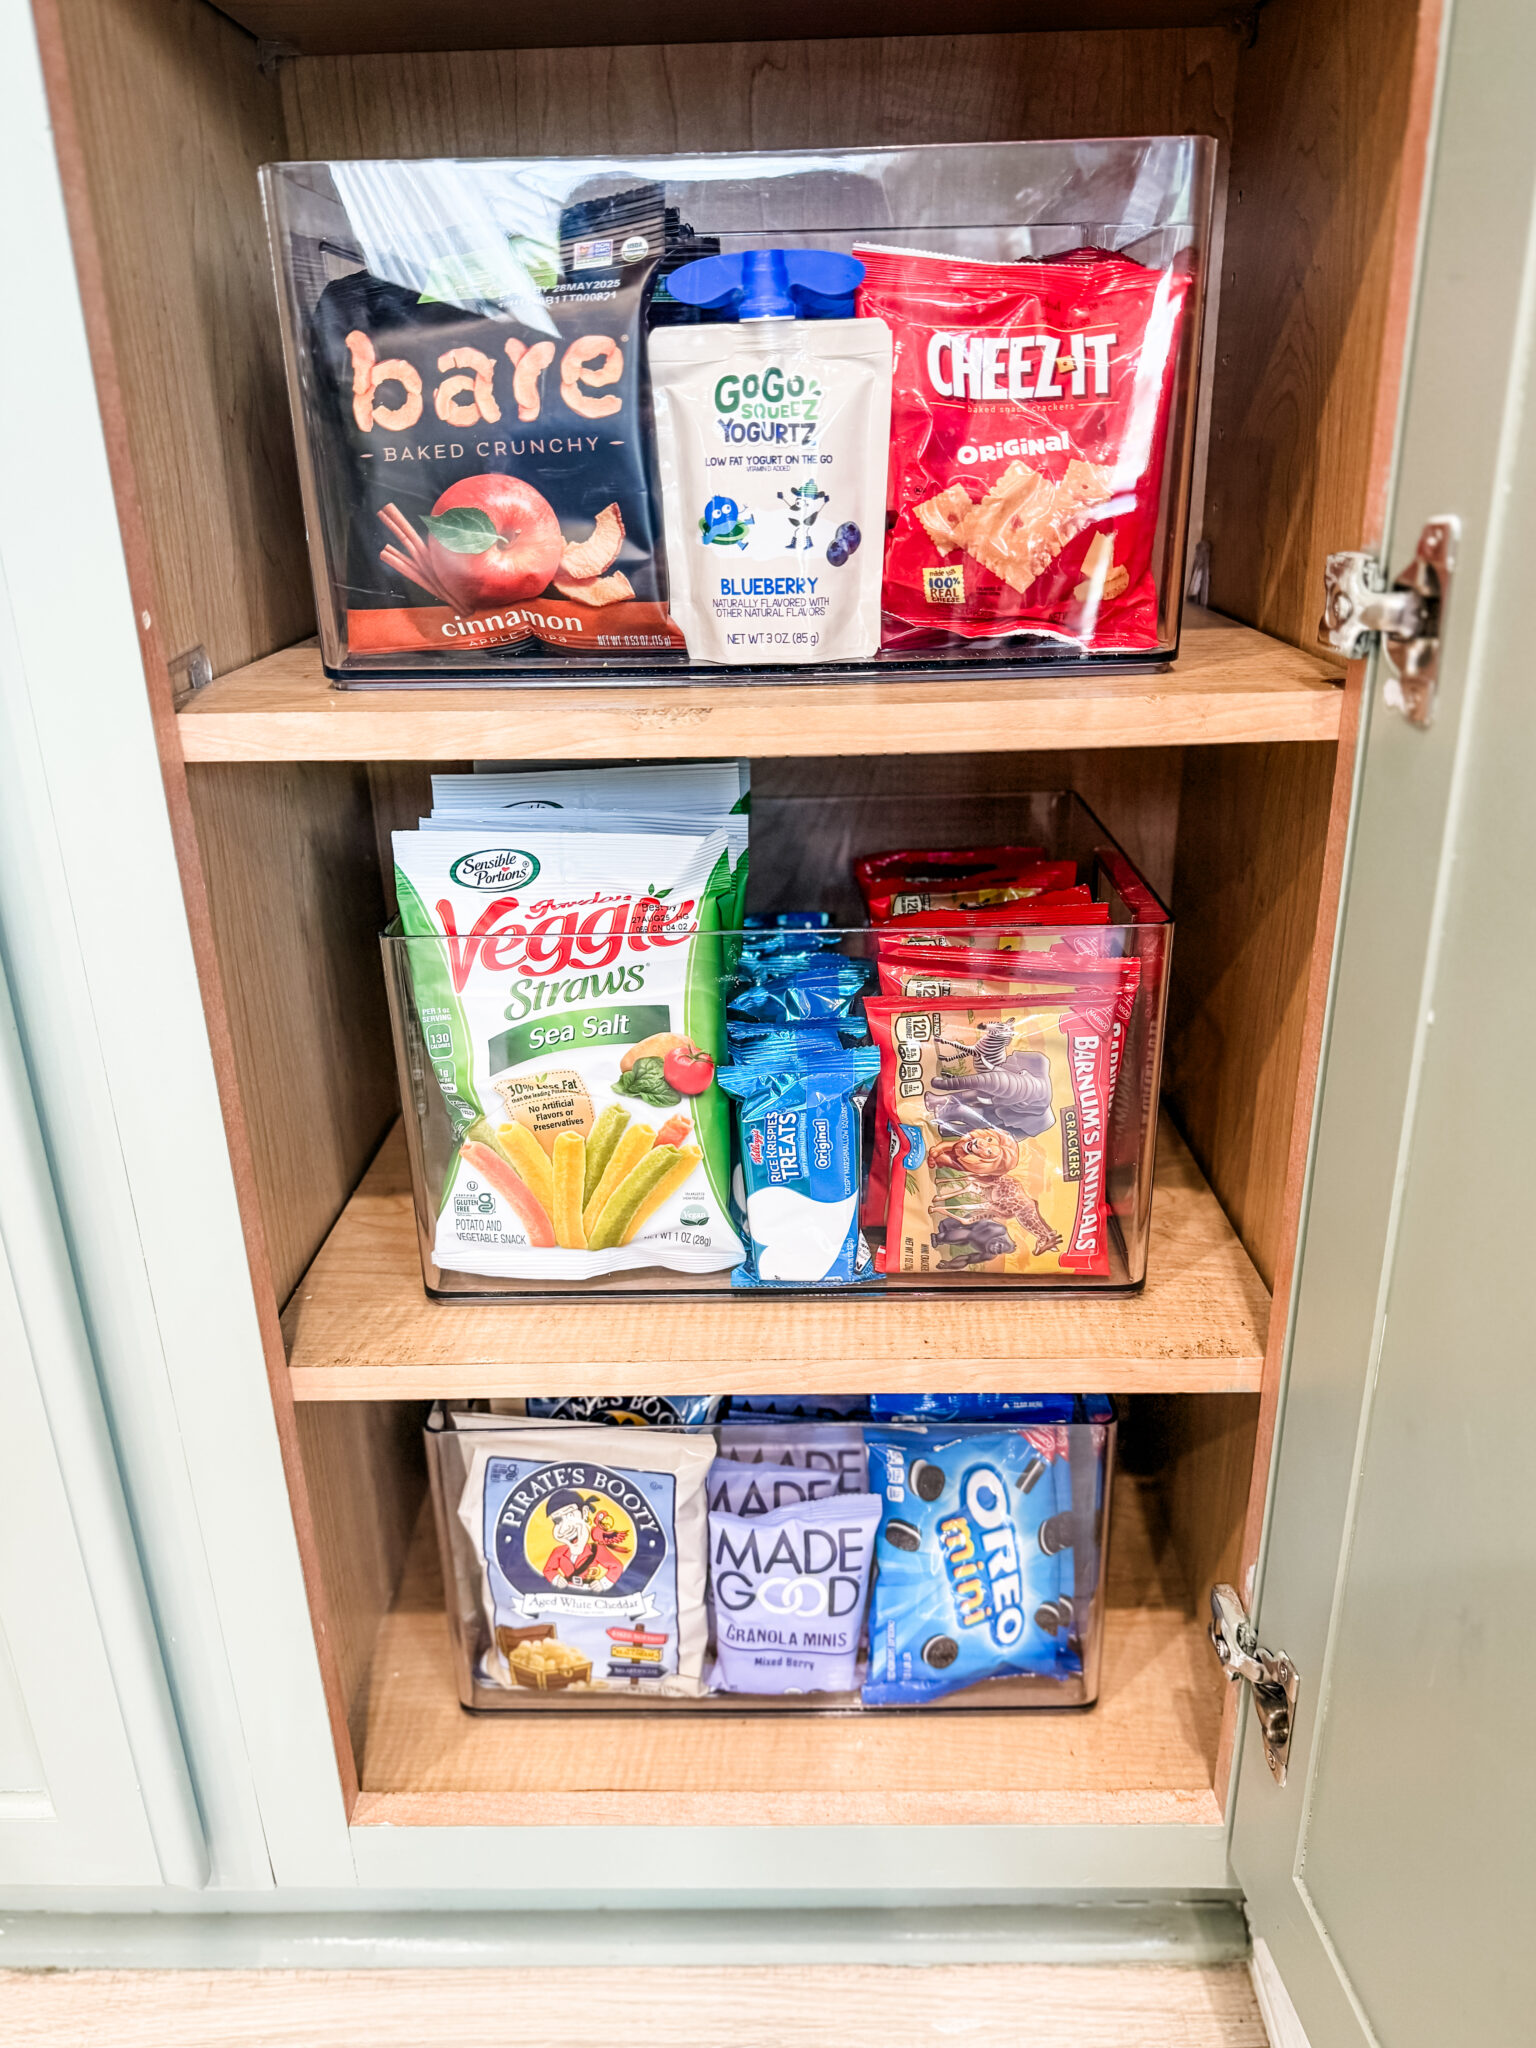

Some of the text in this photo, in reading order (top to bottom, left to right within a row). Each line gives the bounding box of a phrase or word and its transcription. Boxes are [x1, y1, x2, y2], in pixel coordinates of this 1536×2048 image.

[553, 279, 621, 293] 28MAY2025
[345, 330, 624, 433] bare
[967, 404, 996, 414] baked
[1031, 402, 1075, 412] crackers
[717, 418, 817, 446] YOGURTZ
[383, 436, 600, 462] BAKED CRUNCHY
[705, 454, 833, 467] LOW FAT YOGURT ON THE GO
[720, 577, 819, 596] BLUEBERRY
[928, 577, 961, 589] 100%
[930, 588, 960, 598] REAL
[712, 597, 830, 608] NATURALLY FLAVORED WITH
[716, 607, 826, 618] OTHER NATURAL FLAVORS
[441, 609, 583, 637] cinnamon
[727, 634, 746, 645] NET
[766, 633, 773, 644] 3
[774, 633, 790, 644] OZ
[792, 633, 808, 645] (85
[462, 852, 517, 875] Sensible
[474, 868, 527, 887] Portions
[435, 896, 698, 994] Veggie
[503, 964, 646, 1021] Straws
[422, 1014, 452, 1023] SERVING
[912, 1018, 926, 1039] 120
[430, 1033, 450, 1044] 130
[528, 1013, 630, 1050] Sea Salt
[561, 1079, 578, 1090] Fat
[528, 1099, 574, 1114] No Artificial
[536, 1111, 564, 1121] Flavors
[533, 1117, 584, 1131] Preservatives
[766, 1111, 783, 1183] RICE KRISPIES
[777, 1112, 800, 1180] TREATS
[815, 1121, 831, 1168] Original
[841, 1130, 851, 1174] MARSHMALLOW
[1064, 1111, 1081, 1177] CRACKERS
[1073, 1035, 1102, 1251] BARNUM'S ANIMALS
[843, 1175, 852, 1195] CRISPY
[455, 1218, 502, 1232] POTATO AND
[456, 1232, 526, 1245] VEGETABLE SNACK
[681, 1231, 692, 1244] OZ
[692, 1234, 712, 1247] (28g)
[502, 1467, 659, 1533] PIRATE'S BOOTY
[715, 1527, 864, 1574] MADE
[966, 1468, 1023, 1645] OREO
[940, 1516, 992, 1626] mini
[529, 1597, 557, 1608] Aged
[594, 1599, 638, 1609] Cheddar
[716, 1570, 861, 1617] GOOD
[726, 1623, 848, 1648] GRANOLA MINIS
[754, 1656, 815, 1672] Mixed Berry
